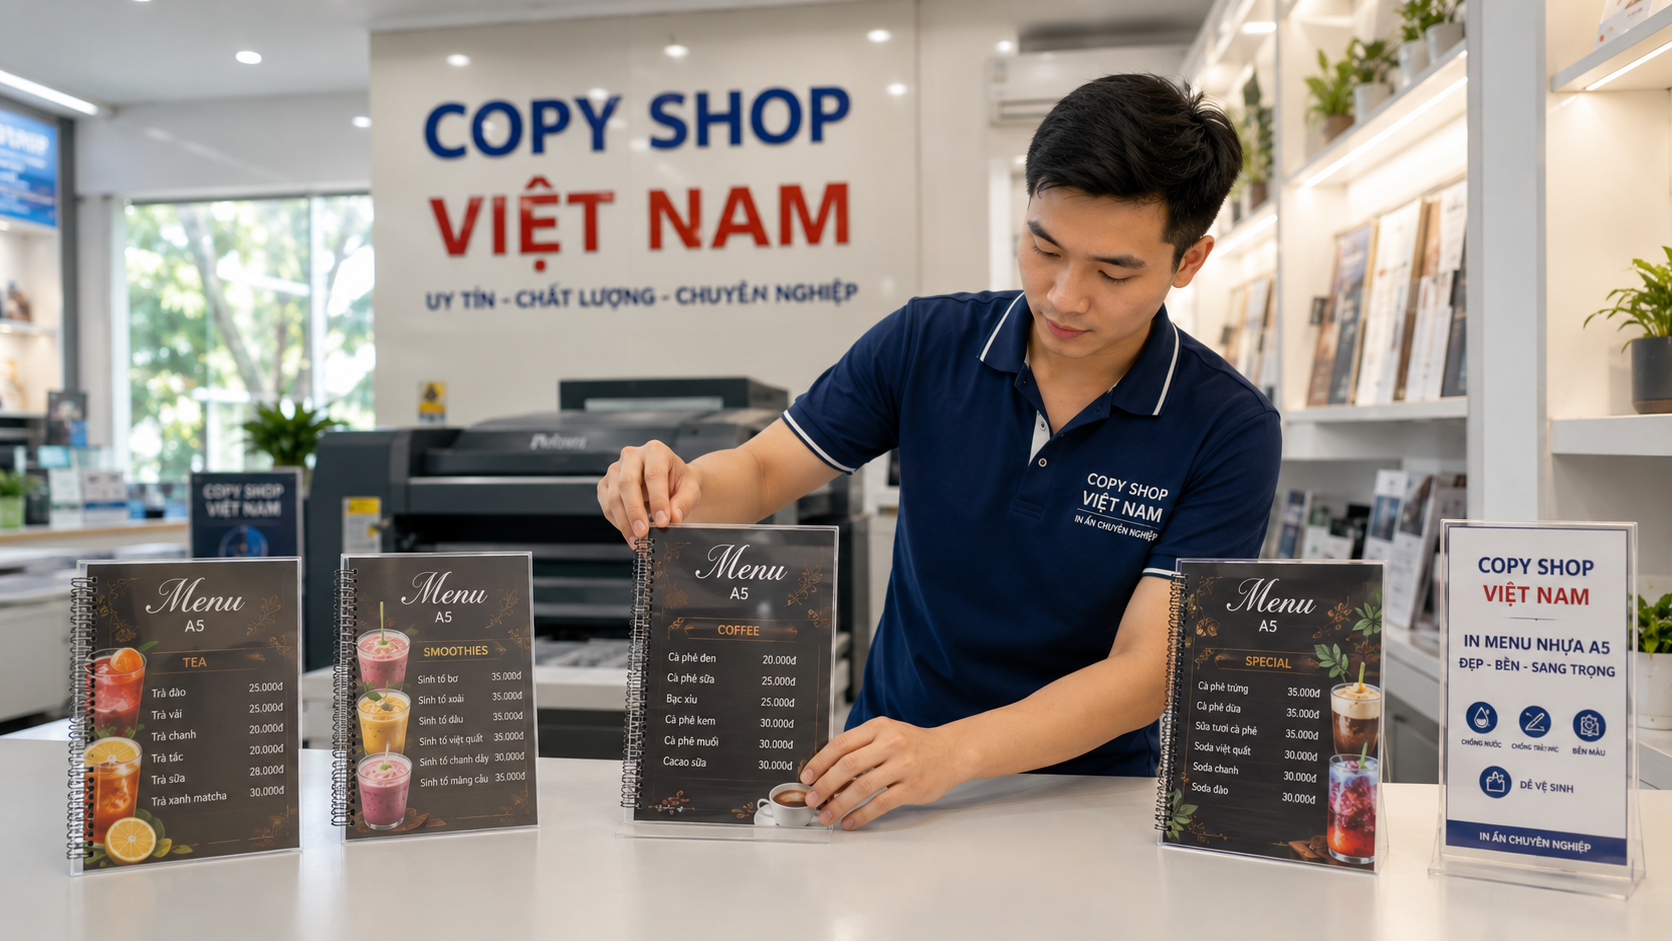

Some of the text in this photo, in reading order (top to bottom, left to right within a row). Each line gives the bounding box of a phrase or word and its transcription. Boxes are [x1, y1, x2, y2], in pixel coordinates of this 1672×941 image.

[424, 86, 852, 159] COPY SHOP
[428, 176, 850, 272] VIỆT NAM
[425, 291, 455, 310] UY
[461, 286, 495, 310] TÍN
[515, 282, 572, 309] CHẤT
[579, 286, 656, 310] LƯỢNG
[675, 280, 768, 305] CHUYÊN
[776, 277, 858, 306] NGHIỆP
[203, 483, 284, 499] COPY SHOP
[1088, 473, 1168, 501] COPY SHOP
[206, 500, 281, 519] VIỆT NAM
[1083, 490, 1163, 523] VIỆT NAM
[1074, 515, 1084, 523] IN
[695, 544, 788, 581] Menu
[1478, 557, 1595, 576] COPY SHOP
[401, 571, 488, 605] Menu
[730, 587, 748, 600] A5
[1483, 580, 1590, 607] VIỆT NAM
[145, 577, 245, 614] Menu
[1226, 578, 1316, 614] Menu
[435, 611, 452, 623] A5
[185, 620, 204, 632] A5
[717, 624, 759, 636] COFFEE
[1259, 620, 1277, 632] A5
[1464, 634, 1610, 656] IN MENU NHỰA A5
[424, 646, 488, 657] SMOOTHIES
[183, 657, 207, 668] TEA
[762, 655, 796, 665] 20.000đ
[1245, 656, 1291, 668] SPECIAL
[1459, 657, 1483, 672] ĐẸP
[1495, 656, 1520, 671] BỀN
[1532, 662, 1567, 674] SANG
[1570, 664, 1615, 679] TRỌNG
[418, 675, 435, 684] Sinh
[762, 676, 796, 686] 25.000đ
[249, 682, 283, 692] 25.000đ
[1288, 687, 1320, 698] 35.000đ
[249, 703, 283, 713] 25.000đ
[761, 698, 795, 707] 25.000đ
[1286, 708, 1319, 719] 35.000đ
[419, 716, 436, 726] Sinh
[697, 716, 716, 725] kem
[760, 719, 794, 728] 30.000đ
[169, 729, 196, 740] chanh
[249, 723, 284, 734] 20.000đ
[1286, 729, 1319, 740] 35.000đ
[420, 737, 436, 746] Sinh
[759, 739, 793, 749] 30.000đ
[250, 744, 284, 755] 20.000đ
[1194, 741, 1214, 752] Soda
[1284, 750, 1318, 762] 30.000đ
[420, 757, 437, 766] Sinh
[450, 754, 473, 764] chanh
[663, 756, 689, 766] Cacao
[759, 760, 792, 770] 30.000đ
[250, 765, 284, 776] 28.000đ
[1193, 762, 1317, 783] Soda chanh 30.000đ
[420, 778, 438, 787] Sinh
[1550, 783, 1574, 793] SINH
[169, 794, 191, 805] xanh
[194, 791, 227, 802] matcha
[250, 786, 284, 797] 30.000đ
[1192, 782, 1211, 792] Soda
[1282, 792, 1316, 804] 30.000đ
[1480, 831, 1591, 854] IN ẤN CHUYÊN NGHIỆP
